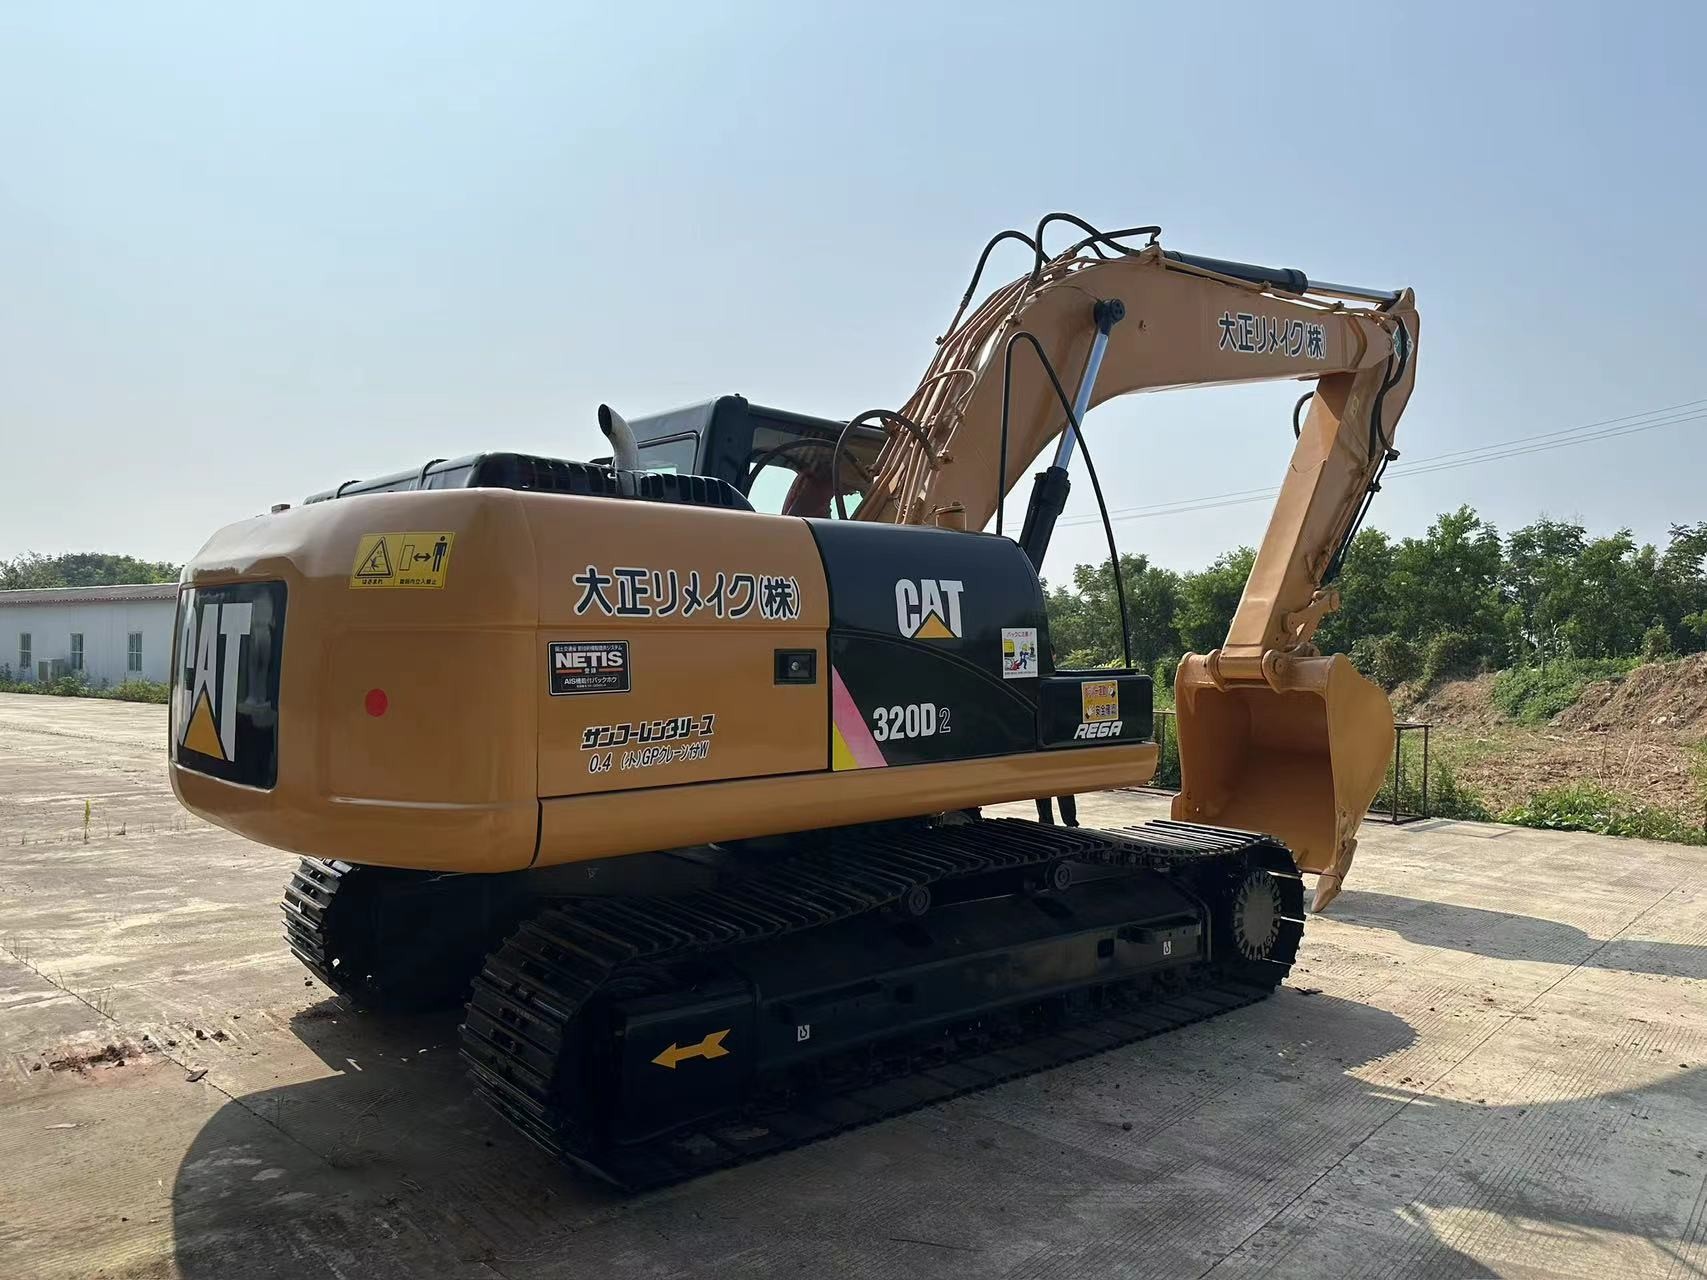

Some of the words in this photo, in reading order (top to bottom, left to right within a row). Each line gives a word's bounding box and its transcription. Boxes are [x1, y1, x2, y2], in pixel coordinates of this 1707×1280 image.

[1218, 311, 1326, 360] 大正リメイク(株)
[572, 564, 801, 620] 大正リメイク(株)
[895, 578, 964, 639] CAT
[177, 602, 253, 763] CAT
[555, 651, 624, 669] NETIS
[1073, 720, 1123, 740] REGA
[588, 751, 613, 774] 0.4
